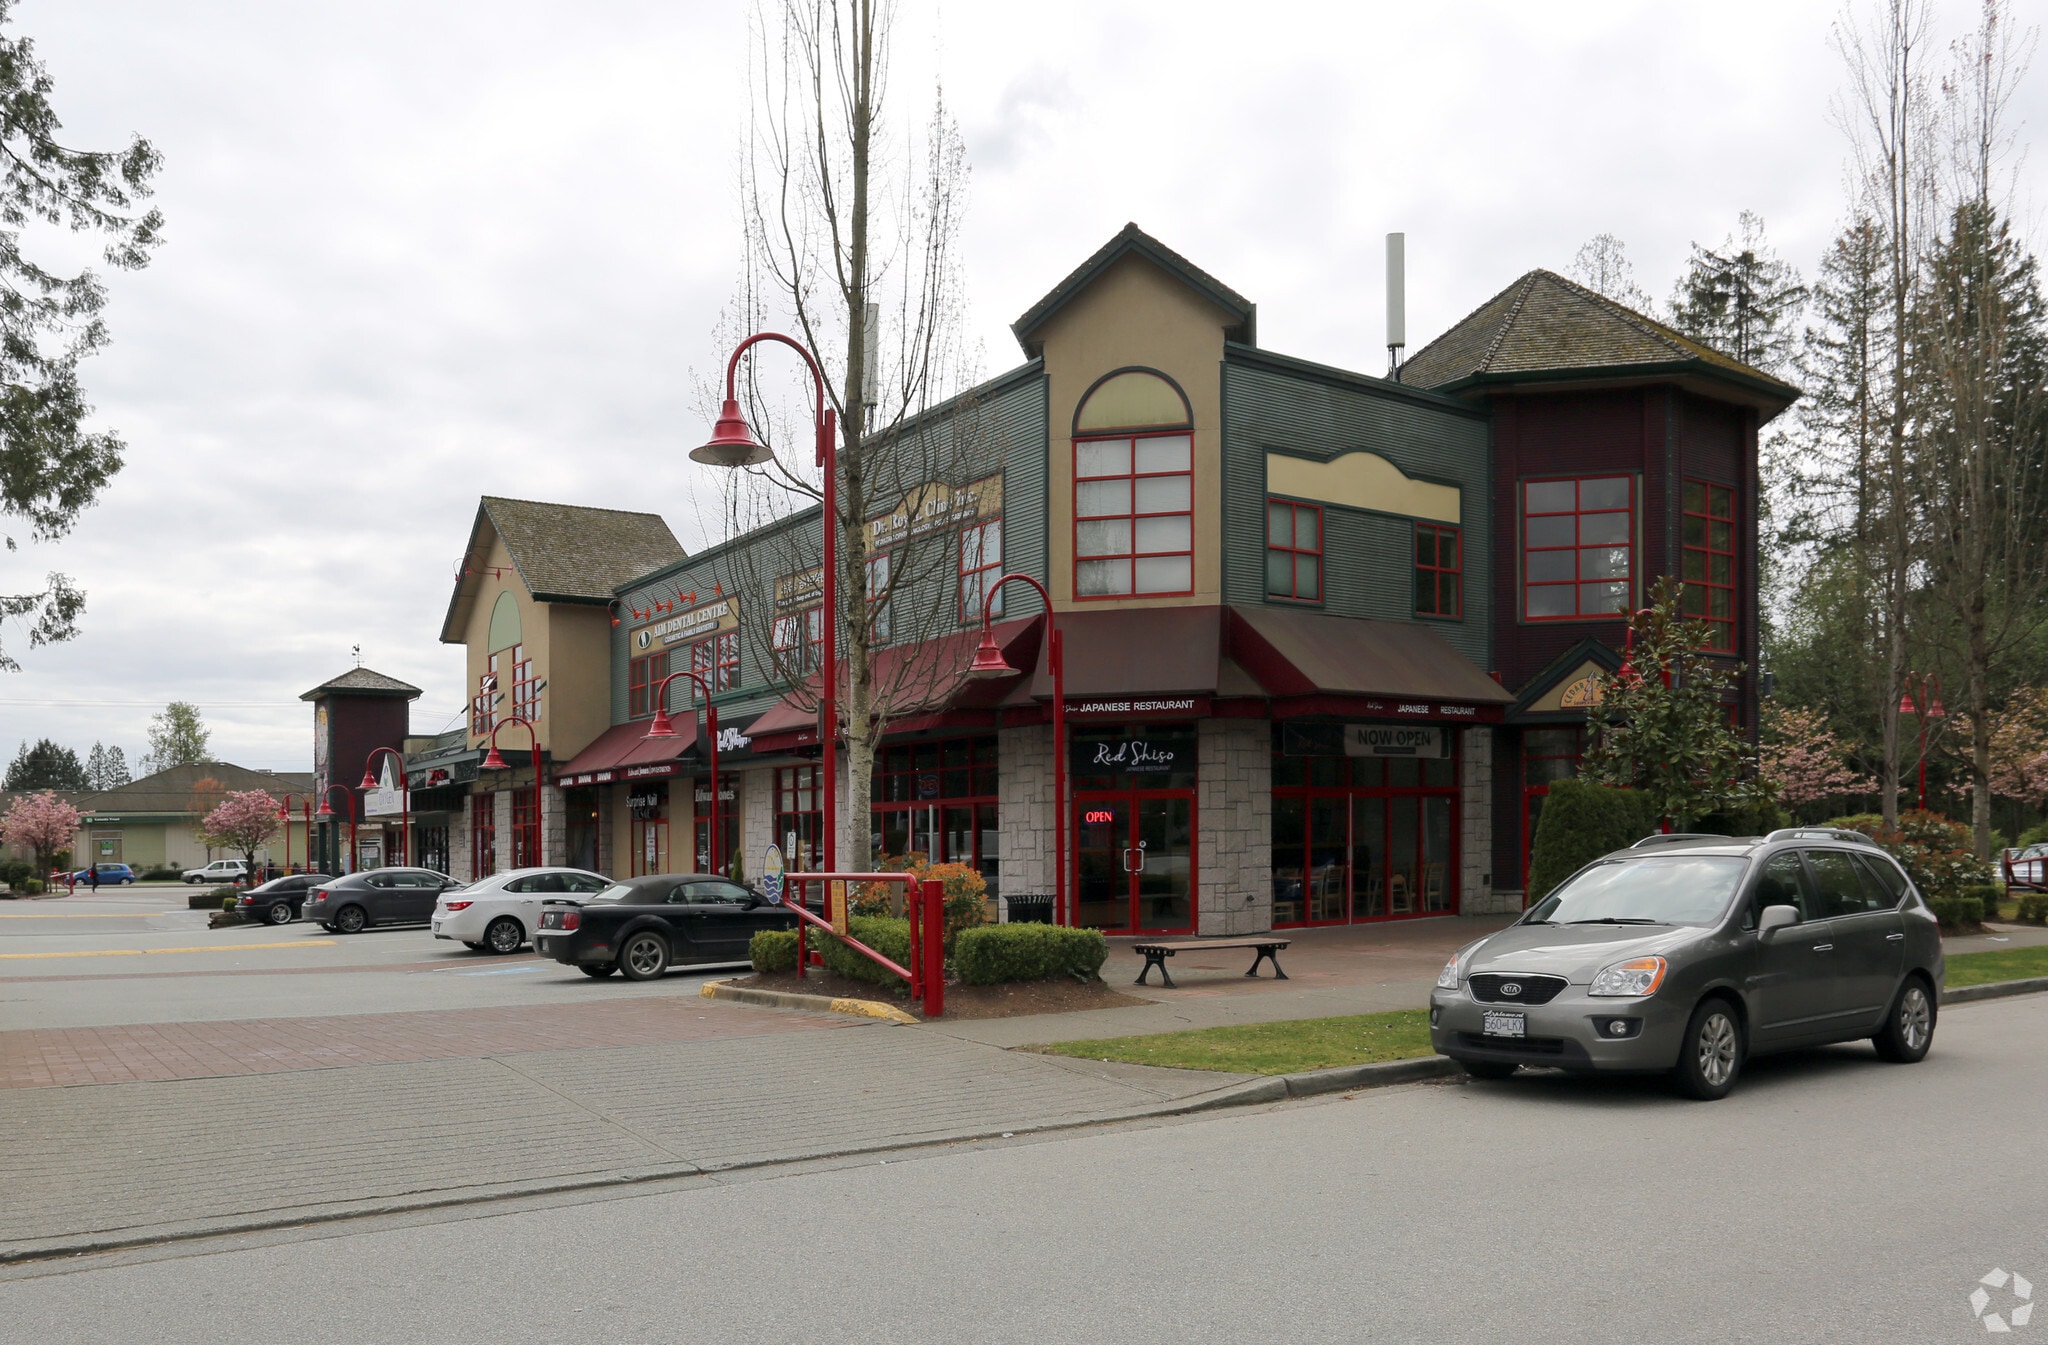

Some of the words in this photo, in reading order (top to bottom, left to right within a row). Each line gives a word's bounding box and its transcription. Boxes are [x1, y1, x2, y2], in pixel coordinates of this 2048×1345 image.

[667, 613, 697, 633] DENTAL
[697, 601, 729, 623] CENTRE
[1080, 702, 1131, 713] JAPANESE
[1133, 700, 1195, 711] RESTAURANT
[1397, 704, 1429, 714] JAPANESE
[1440, 706, 1476, 716] RESTAURANT
[1357, 729, 1392, 746] NOW
[1396, 730, 1431, 747] OPEN
[1093, 742, 1127, 766] Red
[1130, 740, 1174, 766] Shiso
[1085, 811, 1113, 823] OPEN
[1503, 985, 1518, 993] KIA
